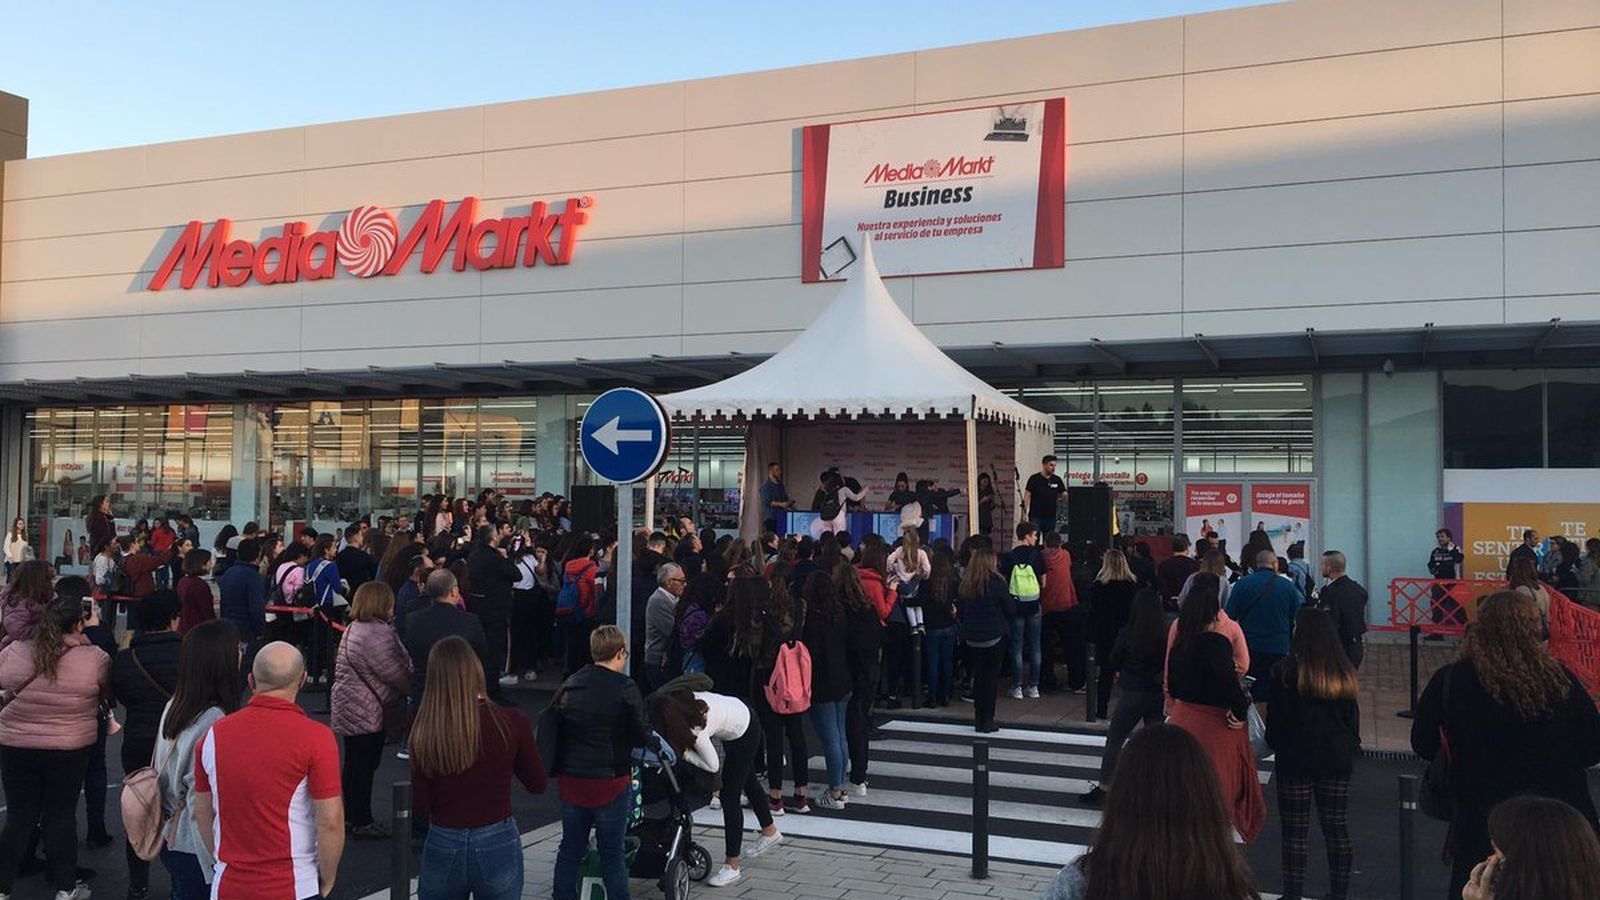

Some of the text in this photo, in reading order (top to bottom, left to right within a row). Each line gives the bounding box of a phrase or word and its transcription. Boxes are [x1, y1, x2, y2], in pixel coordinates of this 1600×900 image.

[864, 156, 994, 184] Media Markt
[884, 186, 973, 209] Business
[857, 213, 1002, 232] Nuestra experiencia y soluciones
[874, 226, 983, 241] al servicio de tu empresa
[147, 218, 340, 291] Media
[1561, 521, 1586, 537] TE
